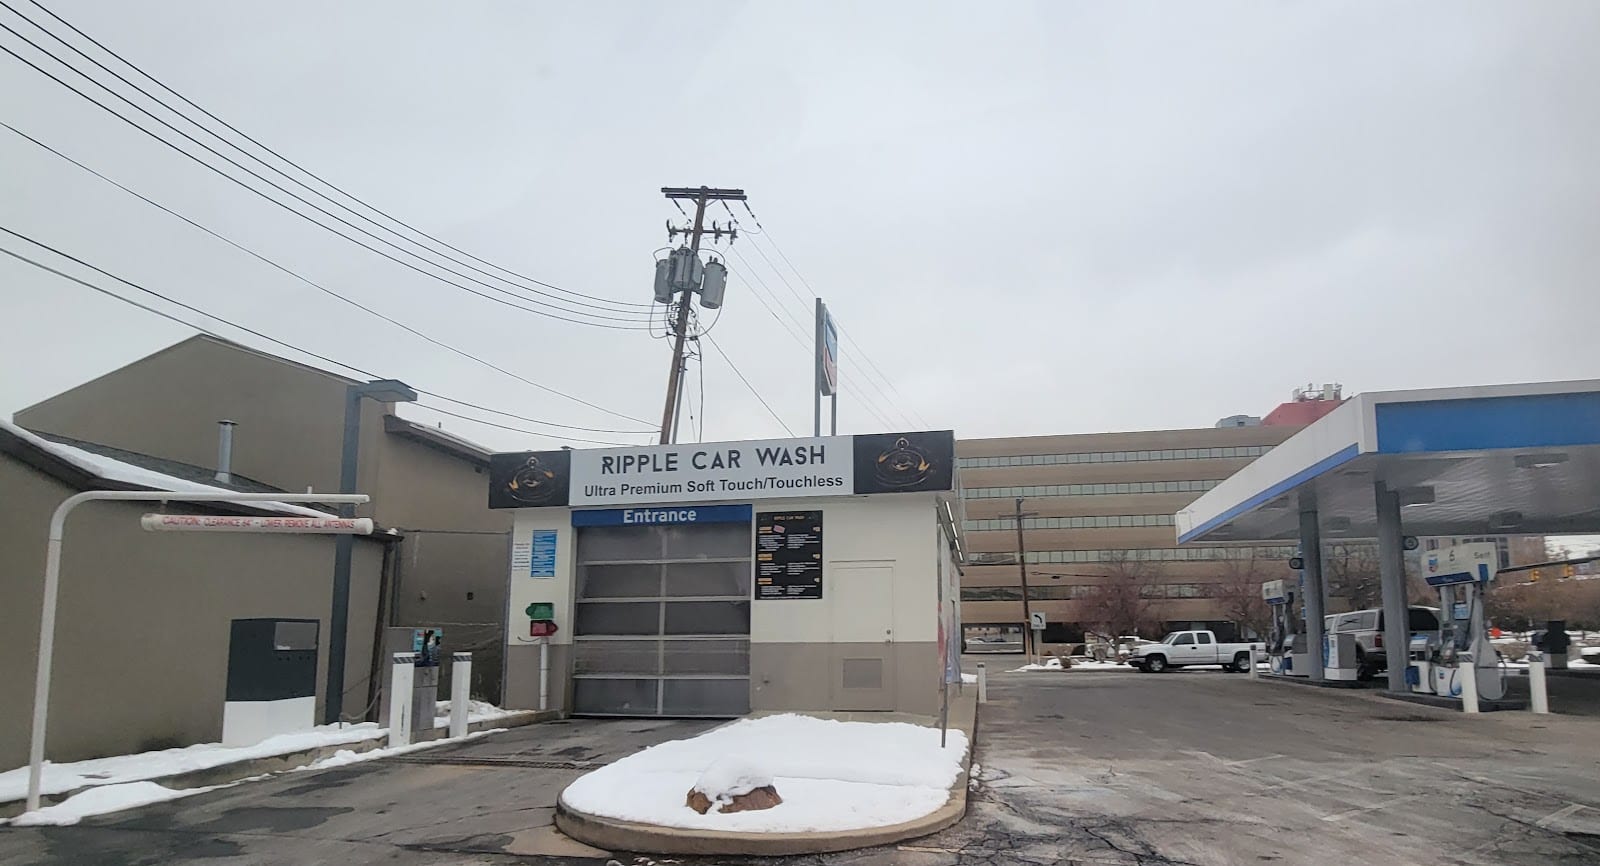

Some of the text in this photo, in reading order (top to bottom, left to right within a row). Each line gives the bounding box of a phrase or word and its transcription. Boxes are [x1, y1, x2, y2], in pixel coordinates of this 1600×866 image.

[601, 444, 825, 475] RIPPLE CAR WASH
[584, 474, 843, 497] Ultra Premium Soft Touch/Touchless
[623, 508, 697, 524] Entrance
